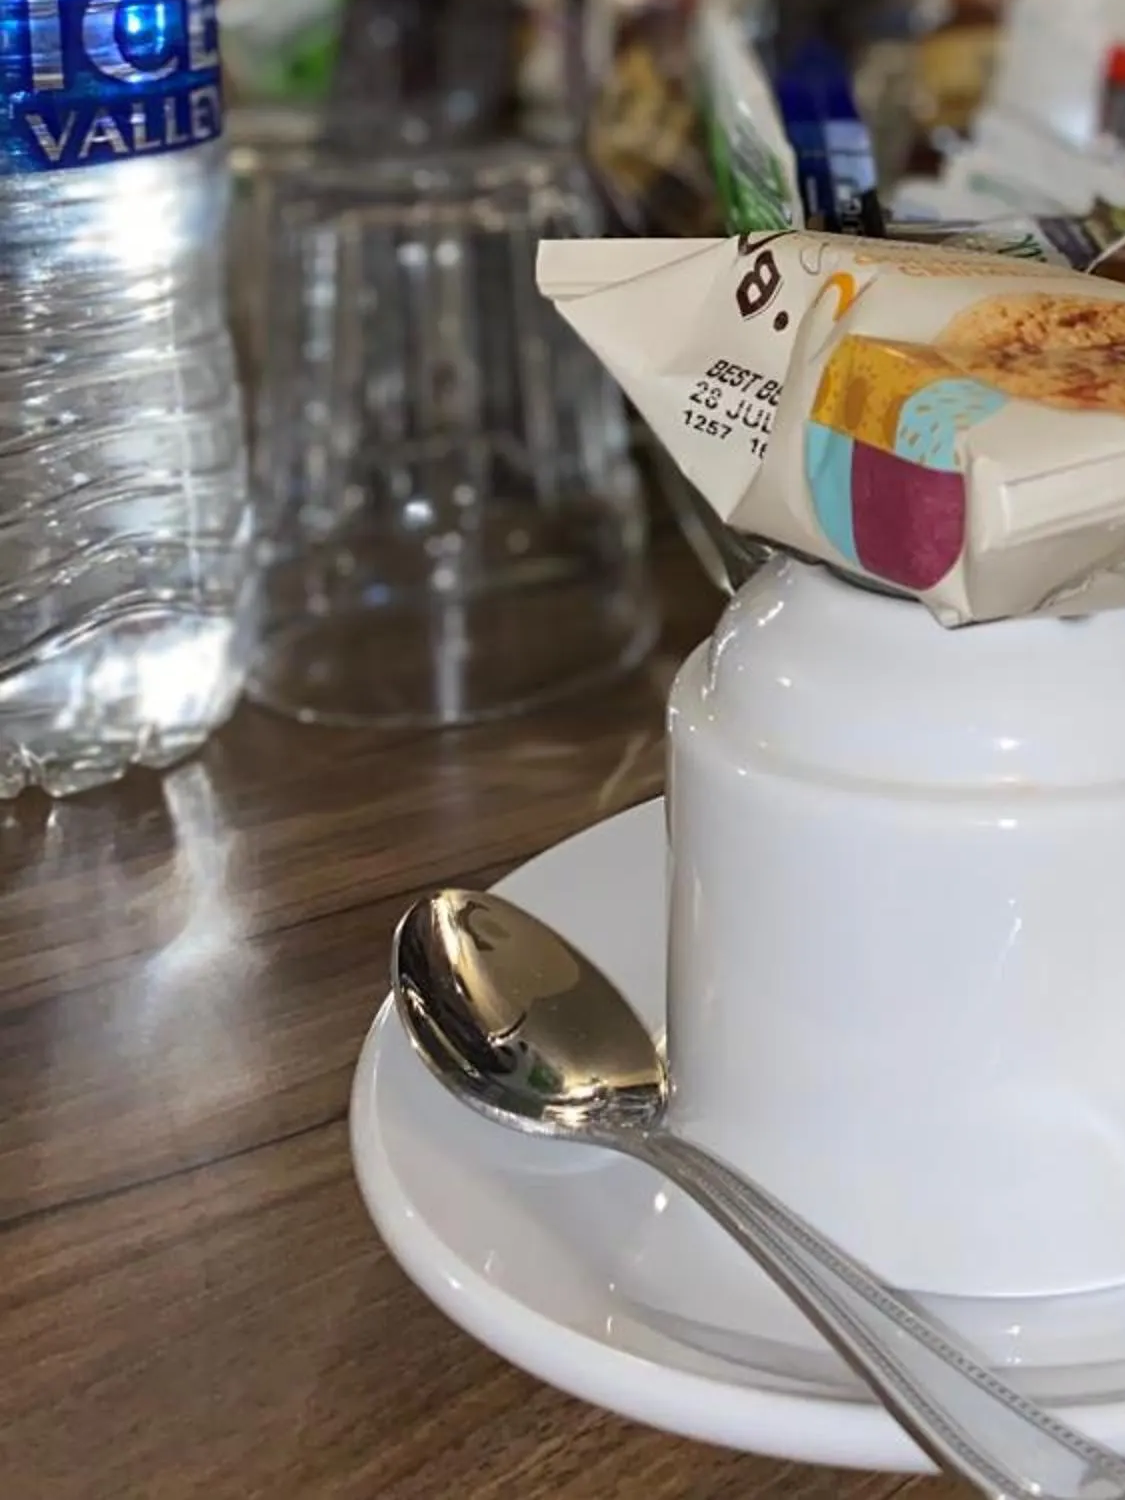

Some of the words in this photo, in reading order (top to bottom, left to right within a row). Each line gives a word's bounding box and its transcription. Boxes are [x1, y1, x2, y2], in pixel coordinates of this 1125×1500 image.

[705, 359, 764, 393] BEST
[682, 409, 733, 440] 1257
[726, 398, 773, 435] JUL
